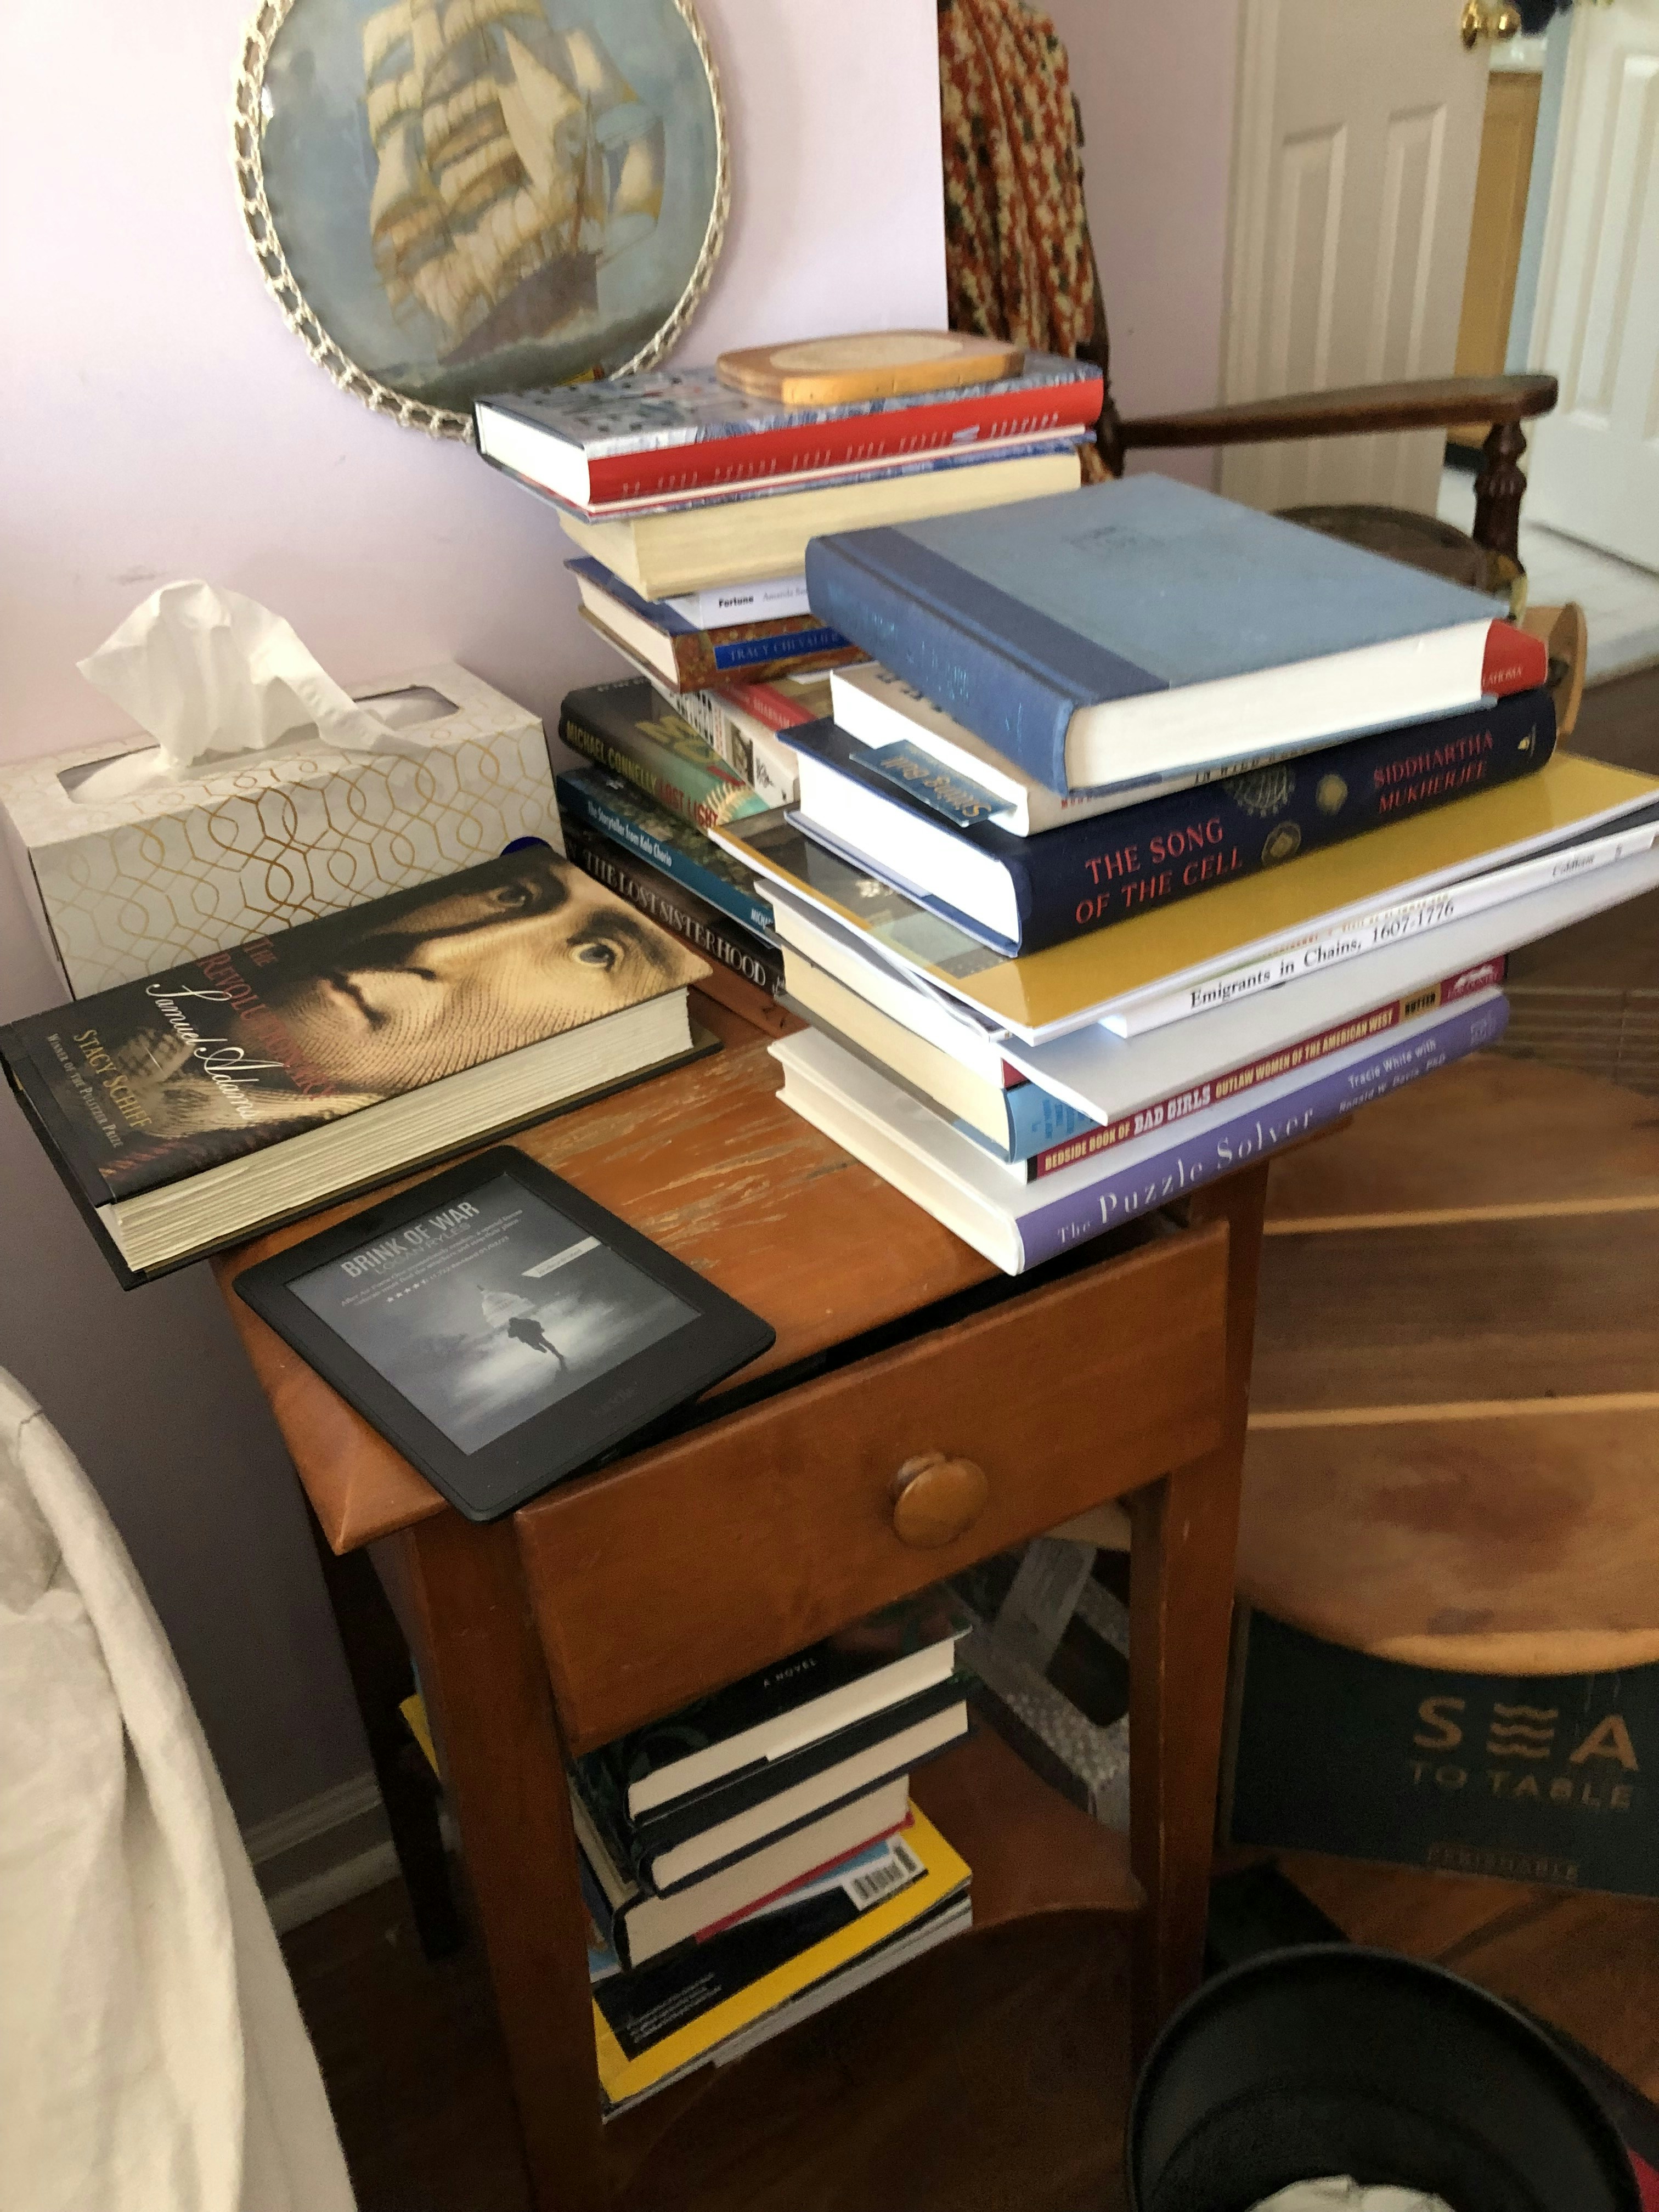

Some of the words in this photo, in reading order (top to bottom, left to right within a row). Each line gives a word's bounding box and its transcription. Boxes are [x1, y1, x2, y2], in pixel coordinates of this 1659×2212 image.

[567, 720, 604, 763] MICHAEL
[608, 747, 657, 795] CONNELLY
[1373, 729, 1493, 789] SIDDHARTHA
[1379, 760, 1487, 814] MUKHERJEE
[1075, 893, 1110, 924] OF
[1120, 869, 1173, 908] THE
[1182, 845, 1243, 887] CELL
[1084, 844, 1141, 885] THE
[1149, 817, 1223, 865] SONG
[582, 850, 618, 888] THE
[619, 871, 659, 914] LOST
[659, 901, 766, 986] SISTERHOOD
[1189, 969, 1271, 1009] Emigrants
[1279, 958, 1295, 977] in
[1304, 939, 1363, 968] Chains,
[1372, 899, 1454, 944] 1607-1776
[74, 1029, 117, 1075] STACY
[103, 1075, 153, 1127] SCHIFF
[145, 984, 233, 1046] Samuel
[193, 1047, 291, 1120] Adams
[1045, 1139, 1087, 1172] BEDSIDE
[1088, 1126, 1116, 1152] BOOK
[1118, 1121, 1131, 1141] OF
[1133, 1105, 1164, 1136] BAD
[1167, 1084, 1211, 1120] GIRLS
[1215, 1068, 1255, 1099] OUTLAW
[1255, 1053, 1291, 1082] WOMEN
[1291, 1047, 1304, 1066] OF
[1305, 1040, 1322, 1060] THE
[1322, 1020, 1368, 1054] AMERICAN
[1369, 1008, 1395, 1034] WEST
[1382, 1049, 1413, 1073] White
[1414, 1039, 1437, 1058] with
[1057, 1220, 1092, 1244] The
[1099, 1158, 1203, 1224] Puzzle
[1217, 1108, 1314, 1170] Solver
[341, 1238, 409, 1278] BRINK
[403, 1224, 431, 1245] OF
[428, 1201, 480, 1231] WAR
[763, 1677, 771, 1688] A
[775, 1658, 817, 1681] NOVEL
[1410, 1759, 1468, 1790] TO
[1487, 1770, 1633, 1809] TABLE
